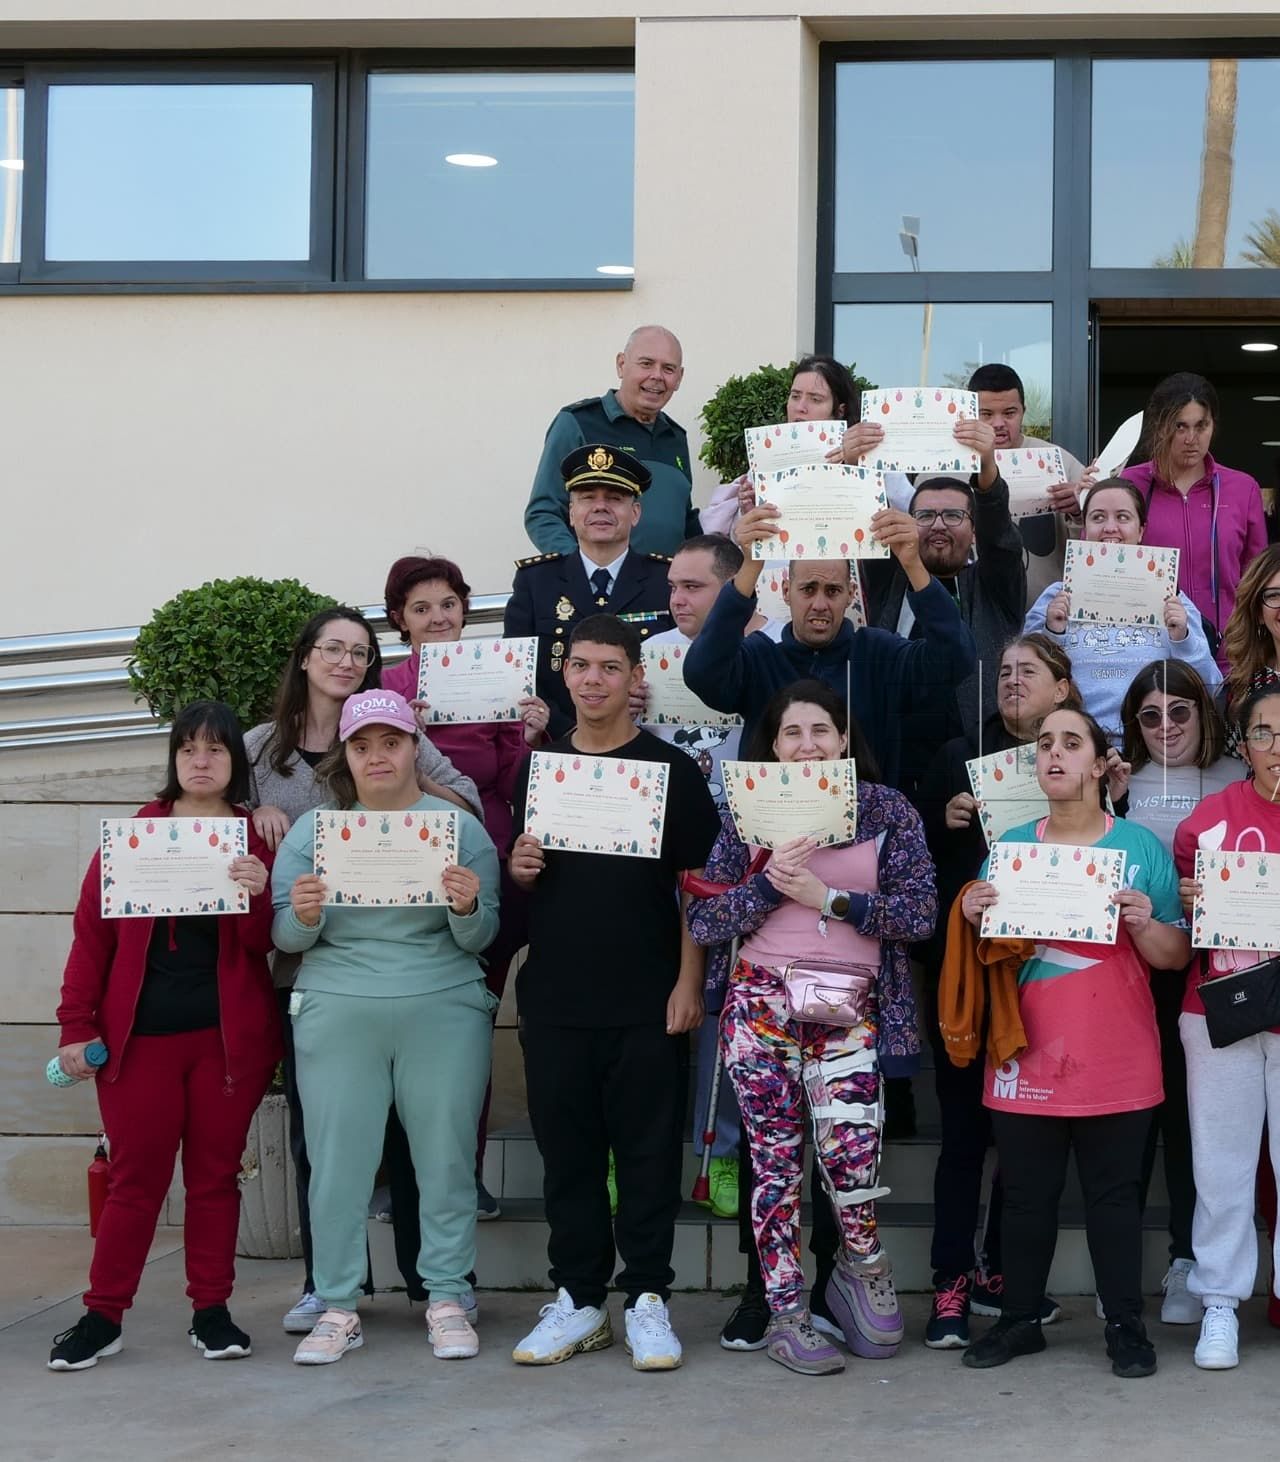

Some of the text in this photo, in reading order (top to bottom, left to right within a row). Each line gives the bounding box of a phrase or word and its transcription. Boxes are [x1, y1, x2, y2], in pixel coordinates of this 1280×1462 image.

[351, 698, 400, 715] ROMA
[1133, 794, 1200, 811] MSTER
[1018, 1086, 1054, 1094] Internacional
[1032, 1094, 1049, 1102] Mujer
